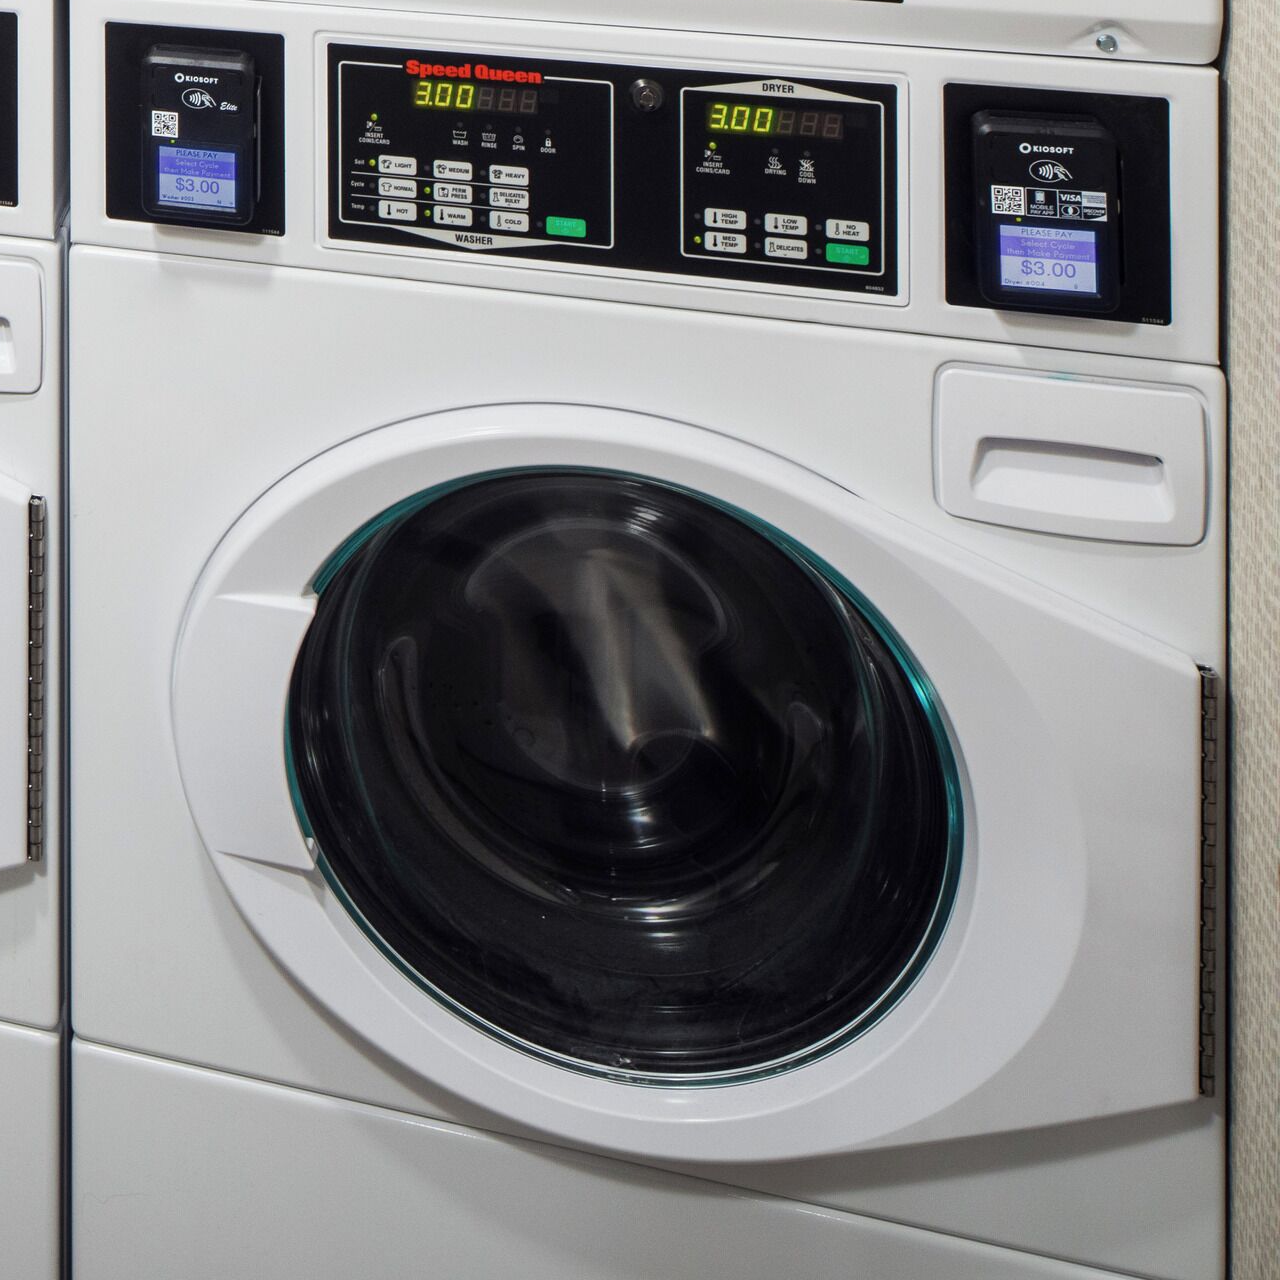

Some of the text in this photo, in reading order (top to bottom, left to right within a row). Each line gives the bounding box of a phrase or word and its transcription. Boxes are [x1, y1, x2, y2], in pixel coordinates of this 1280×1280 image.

[406, 60, 543, 84] Speed Queen
[185, 76, 218, 84] KIOSOFT
[762, 84, 794, 94] DRYER
[414, 82, 474, 108] 3.00
[220, 102, 238, 112] Elite
[710, 104, 772, 132] 3.00
[1032, 146, 1074, 154] KIOSOFT
[696, 166, 730, 174] COINS/CARD
[176, 178, 220, 194] $3.00
[1021, 228, 1052, 236] PLEASE
[455, 234, 492, 245] WASHER
[776, 245, 804, 253] DELICATES
[1050, 242, 1076, 250] Cycle
[1028, 249, 1050, 257] Make
[1054, 250, 1090, 260] Payment
[1022, 260, 1076, 278] $3.00
